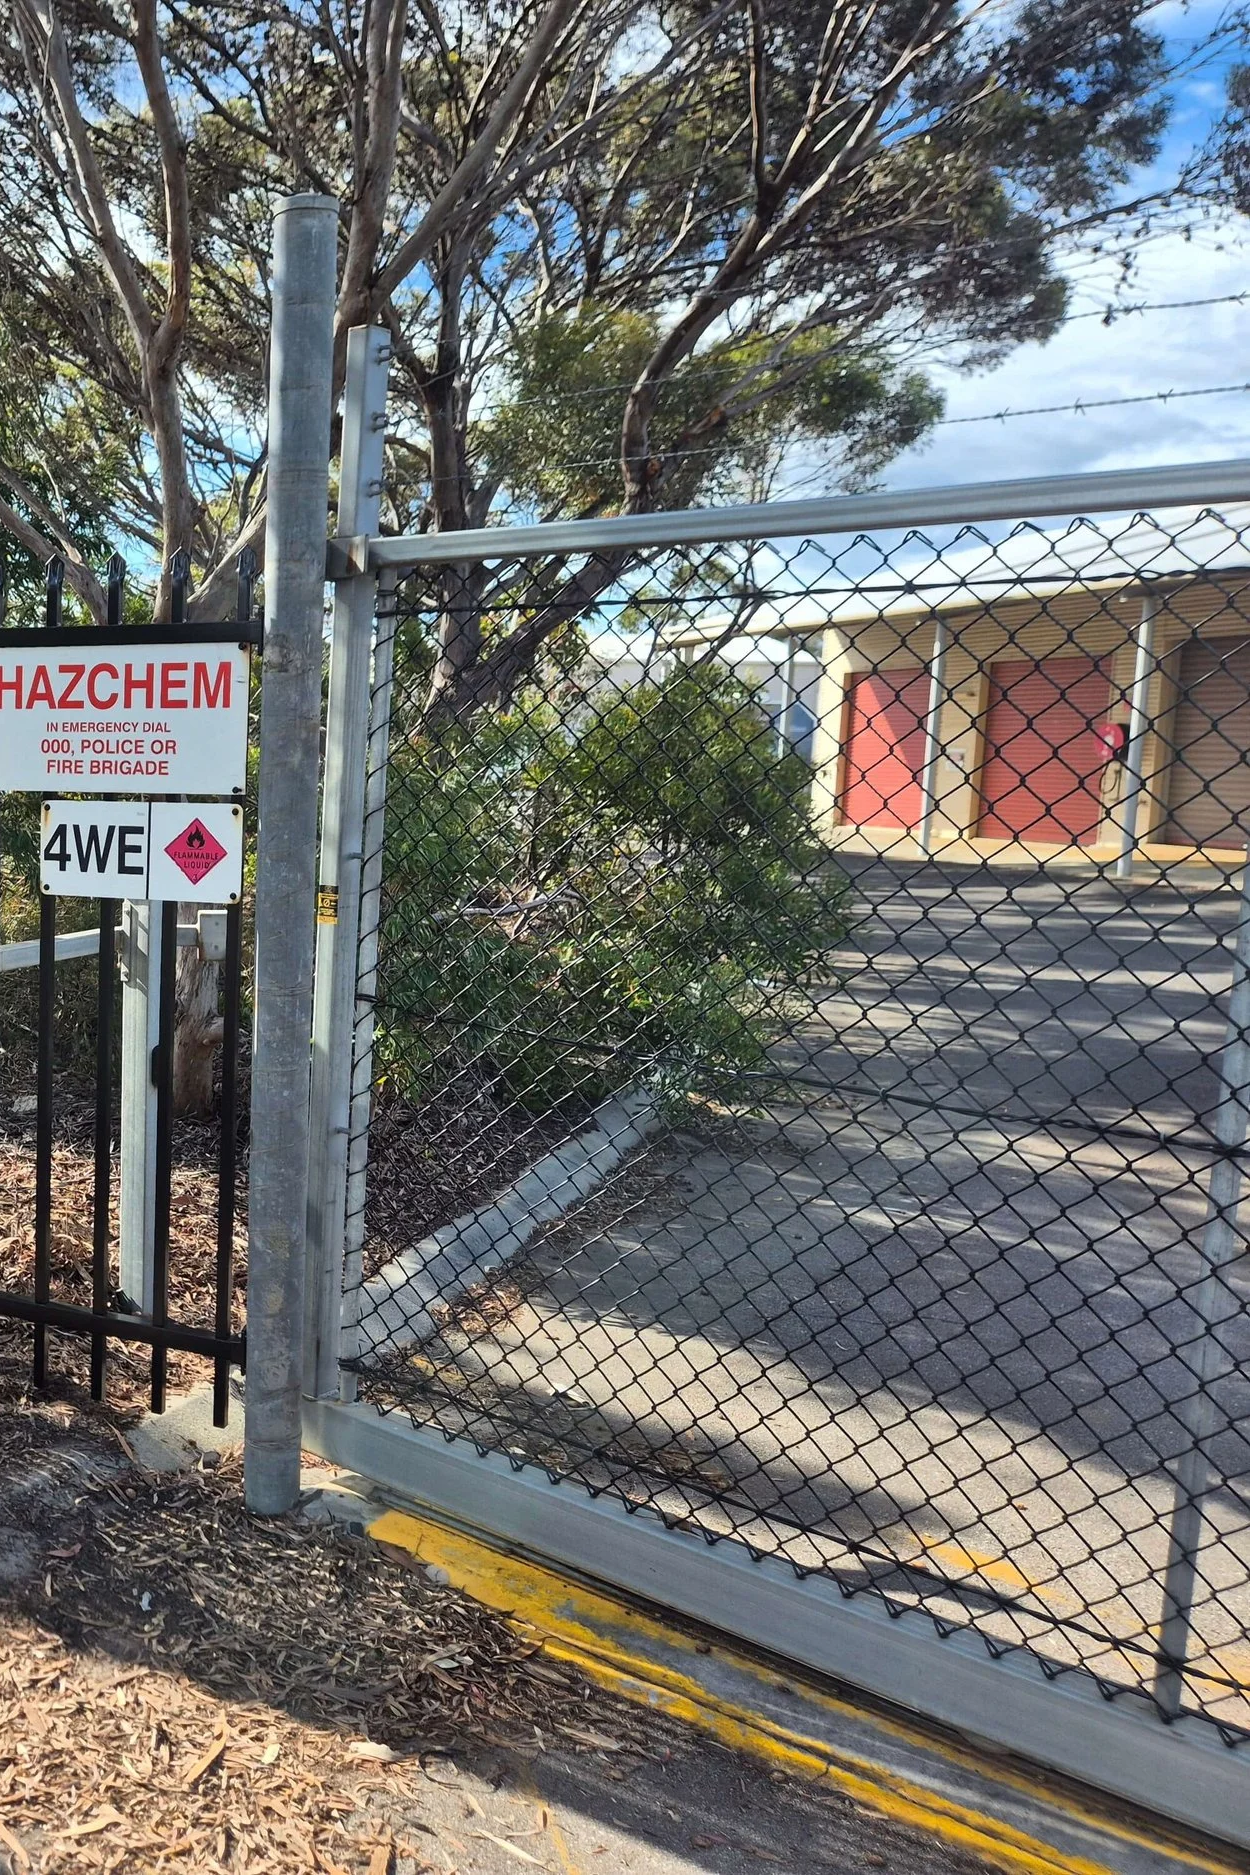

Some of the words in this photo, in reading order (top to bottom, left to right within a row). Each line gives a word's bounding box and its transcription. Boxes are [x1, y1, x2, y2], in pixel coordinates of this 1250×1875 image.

[46, 722, 59, 733] IN
[62, 722, 140, 733] EMERGENCY
[142, 722, 171, 733] DIAL
[40, 739, 75, 756] 000,
[80, 739, 145, 755] POLICE
[151, 739, 177, 755] OR
[46, 760, 84, 775] FIRE
[90, 760, 169, 776] BRIGADE
[43, 823, 145, 876] 4WE
[173, 851, 219, 861] FLAMMABLE
[183, 861, 210, 870] LIQUID
[191, 873, 198, 881] 3
